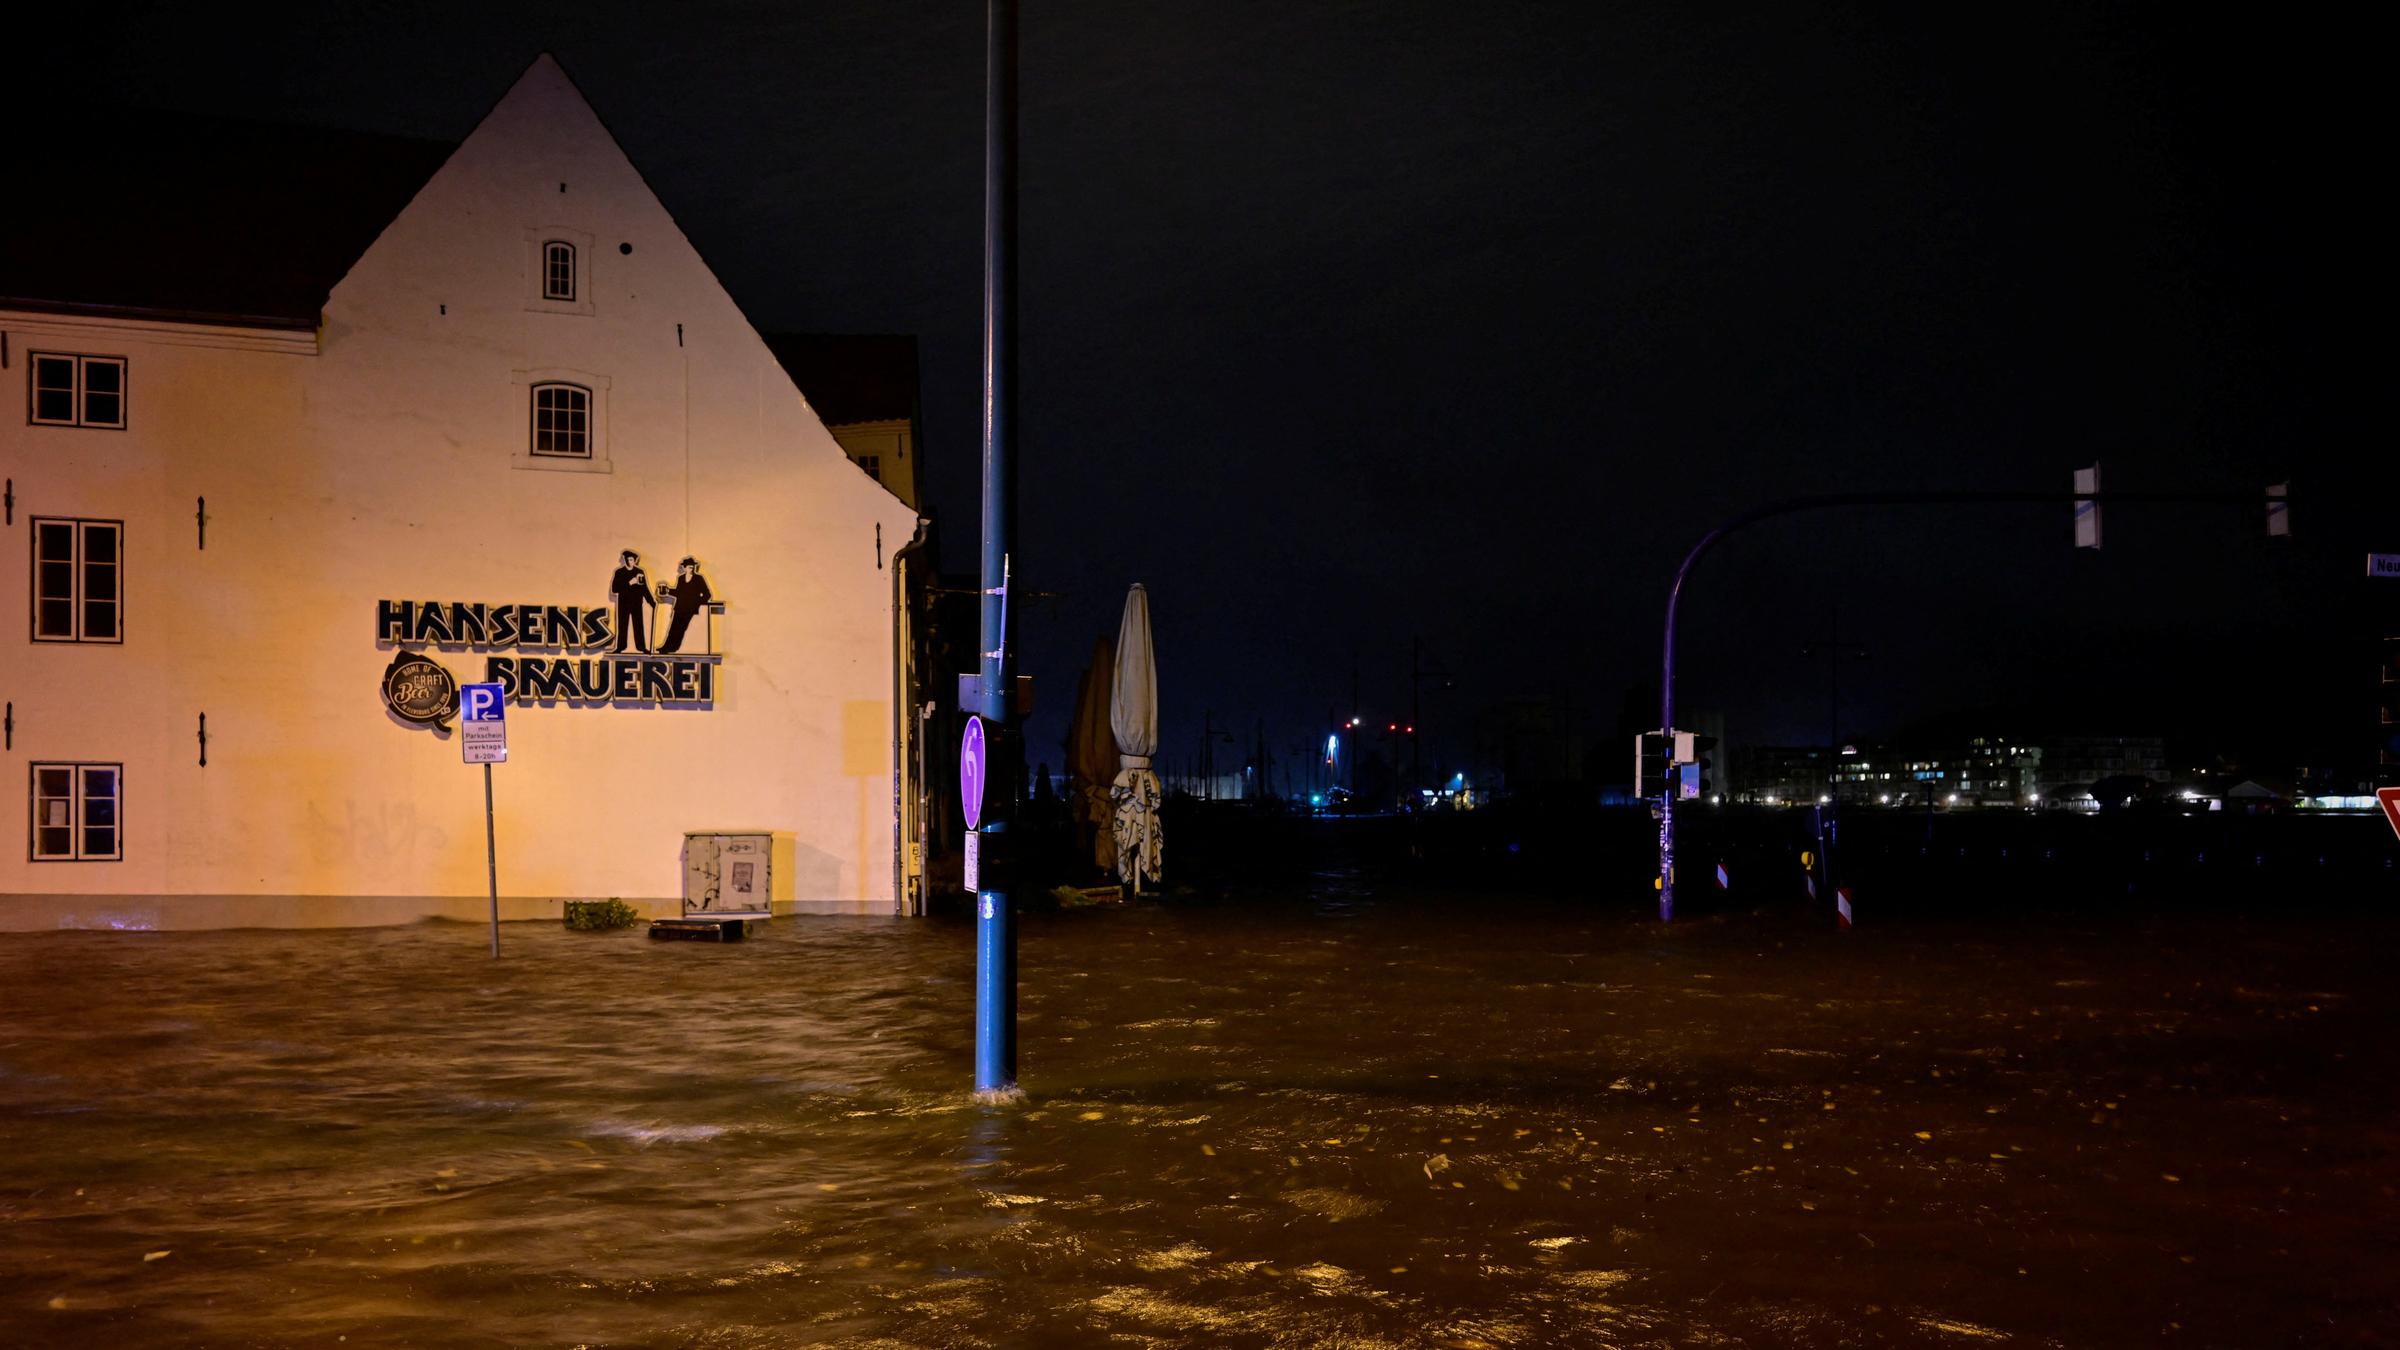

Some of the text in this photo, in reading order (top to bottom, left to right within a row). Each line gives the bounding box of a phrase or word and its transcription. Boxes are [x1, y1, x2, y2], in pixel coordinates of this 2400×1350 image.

[379, 600, 614, 646] HANSENS
[402, 664, 432, 677] HOME OF
[413, 674, 443, 686] CRAFT
[488, 656, 714, 701] BRAUEREI
[394, 682, 430, 704] Beer
[470, 688, 494, 721] P
[468, 743, 501, 751] werktags
